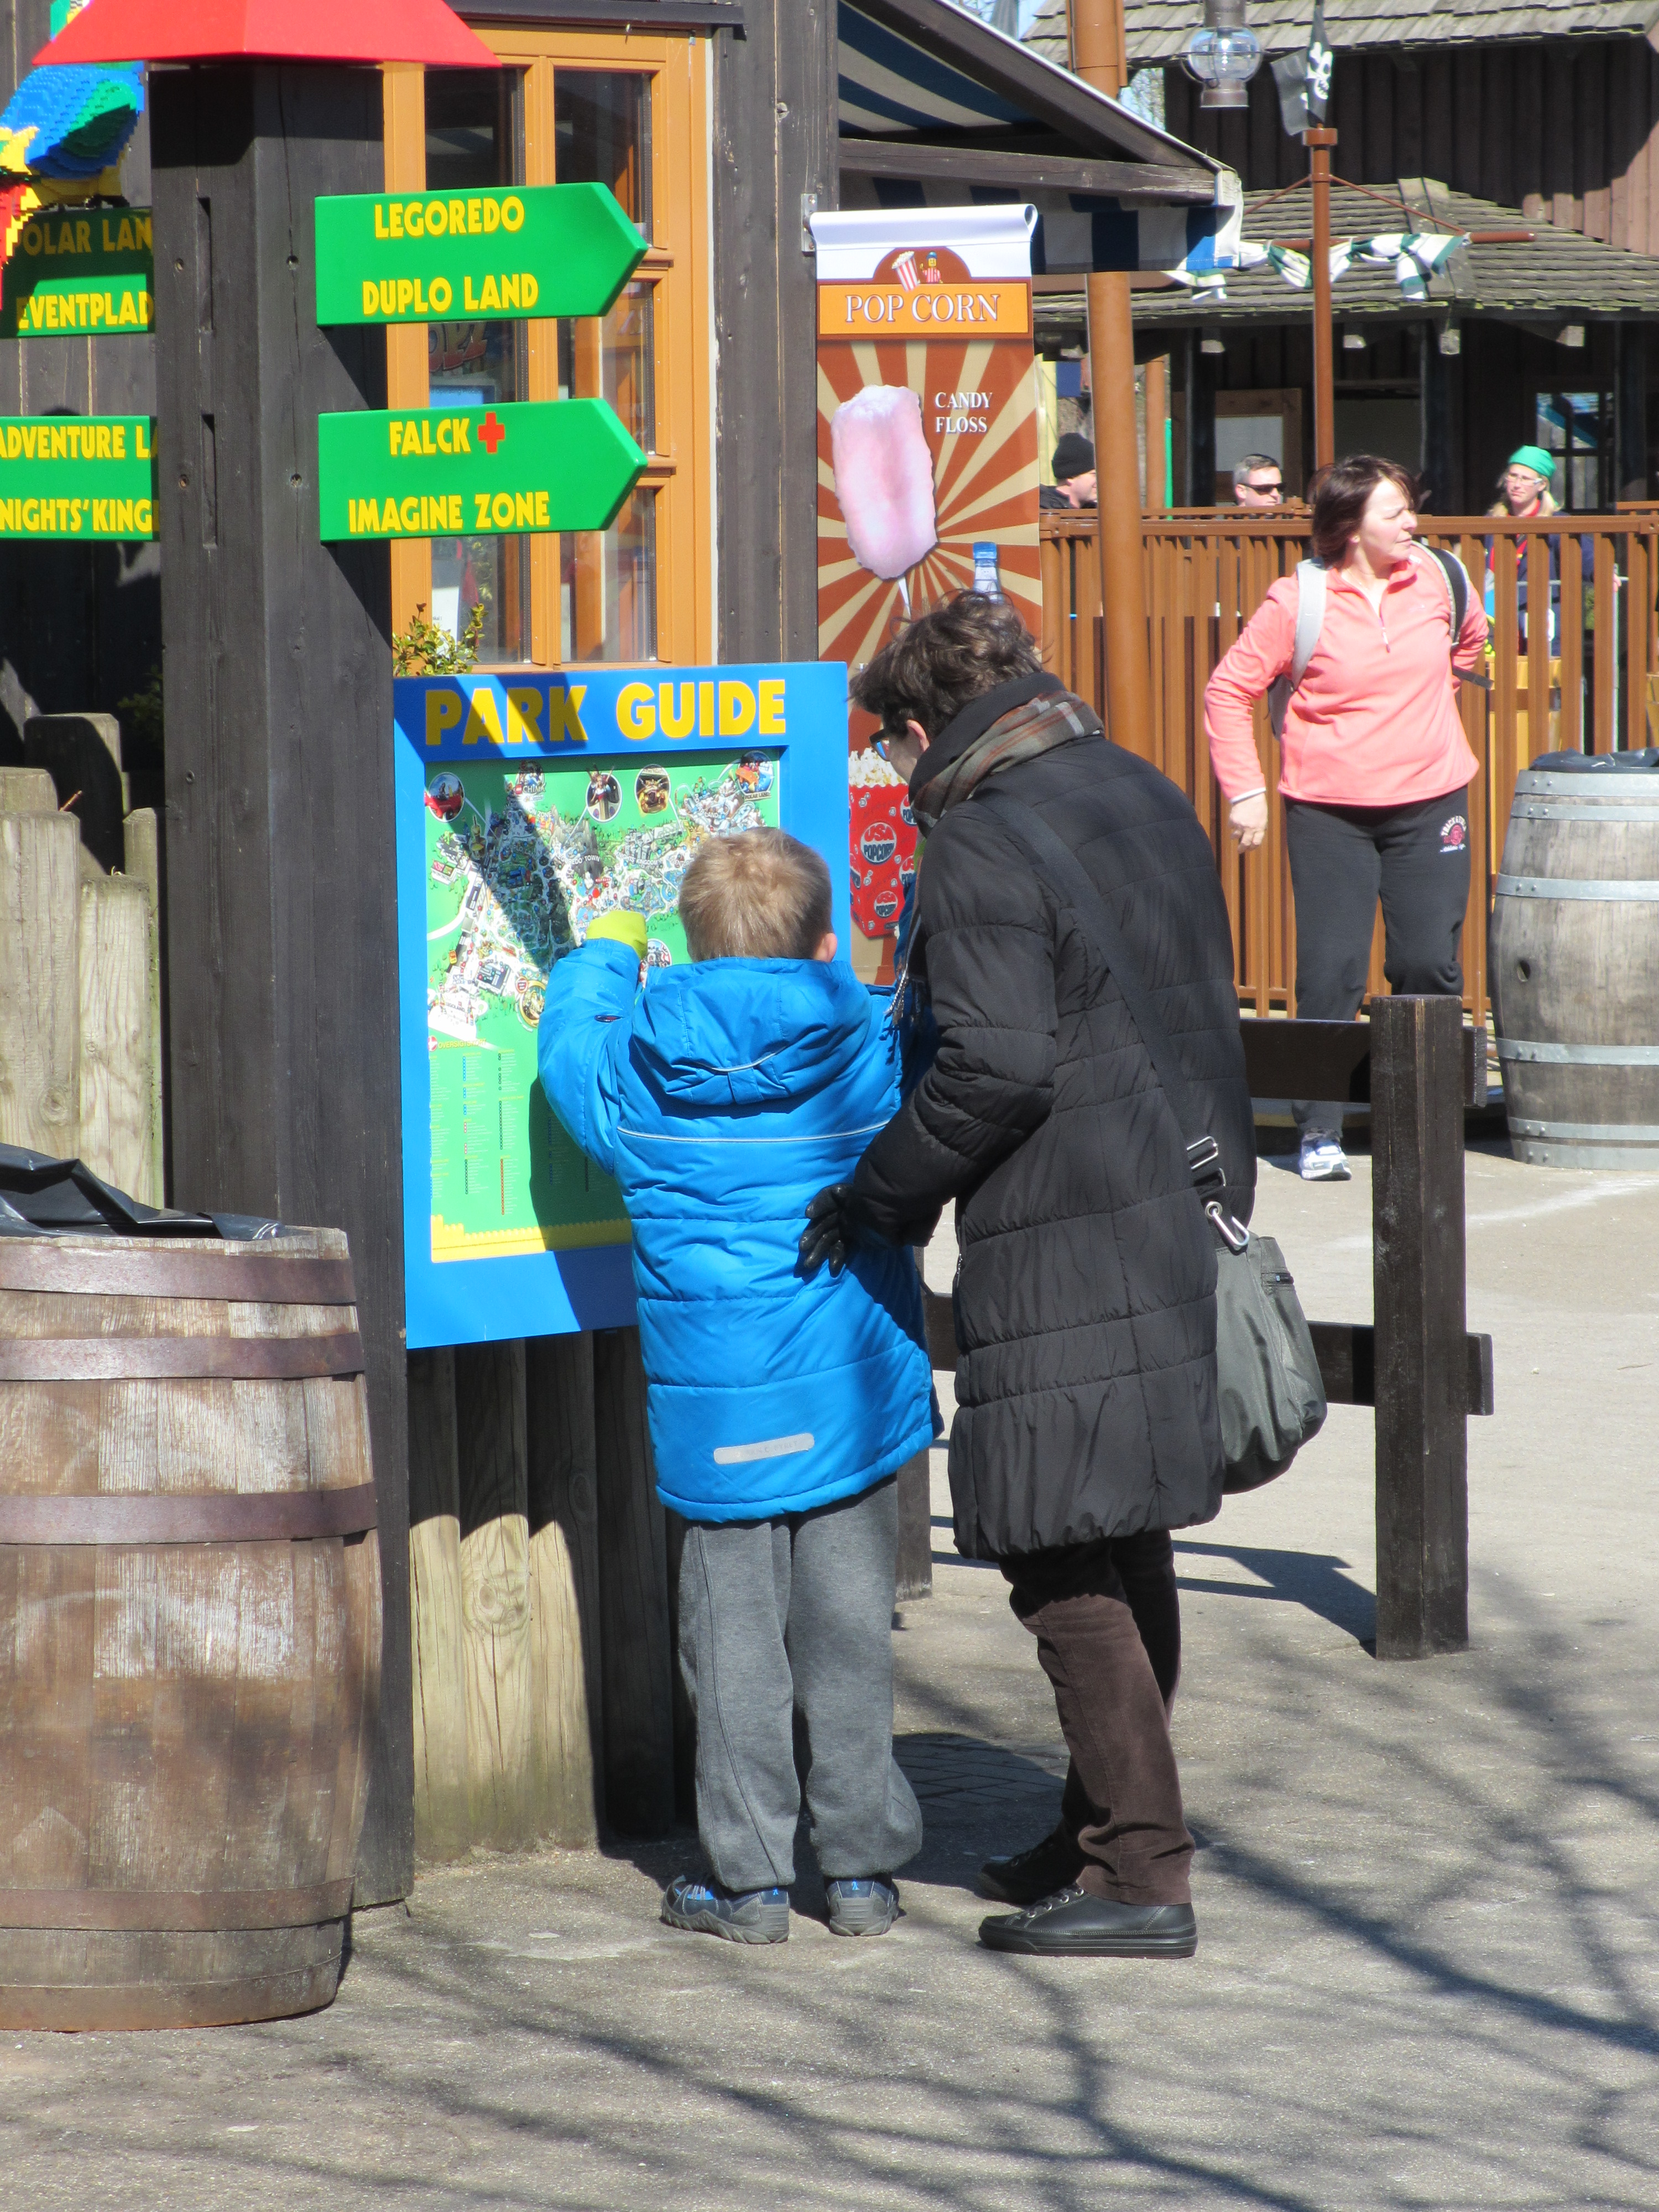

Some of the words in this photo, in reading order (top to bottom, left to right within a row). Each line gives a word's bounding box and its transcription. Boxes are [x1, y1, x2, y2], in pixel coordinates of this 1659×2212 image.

[374, 196, 525, 238] LEGOREDO
[22, 221, 92, 256] OLAR
[16, 291, 154, 330] EVENTPLAD
[363, 276, 452, 316] DUPLO
[464, 273, 539, 311] LAND
[845, 294, 904, 323] POP
[911, 293, 1000, 322] CORN
[935, 392, 993, 409] CANDY
[389, 418, 471, 456] FALCK
[936, 416, 988, 434] FLOSS
[348, 495, 463, 533] IMAGINE
[474, 491, 550, 528] ZONE
[425, 685, 588, 745] PARK
[616, 679, 786, 740] GUIDE
[864, 824, 894, 842] USA
[864, 843, 895, 861] POPCORN
